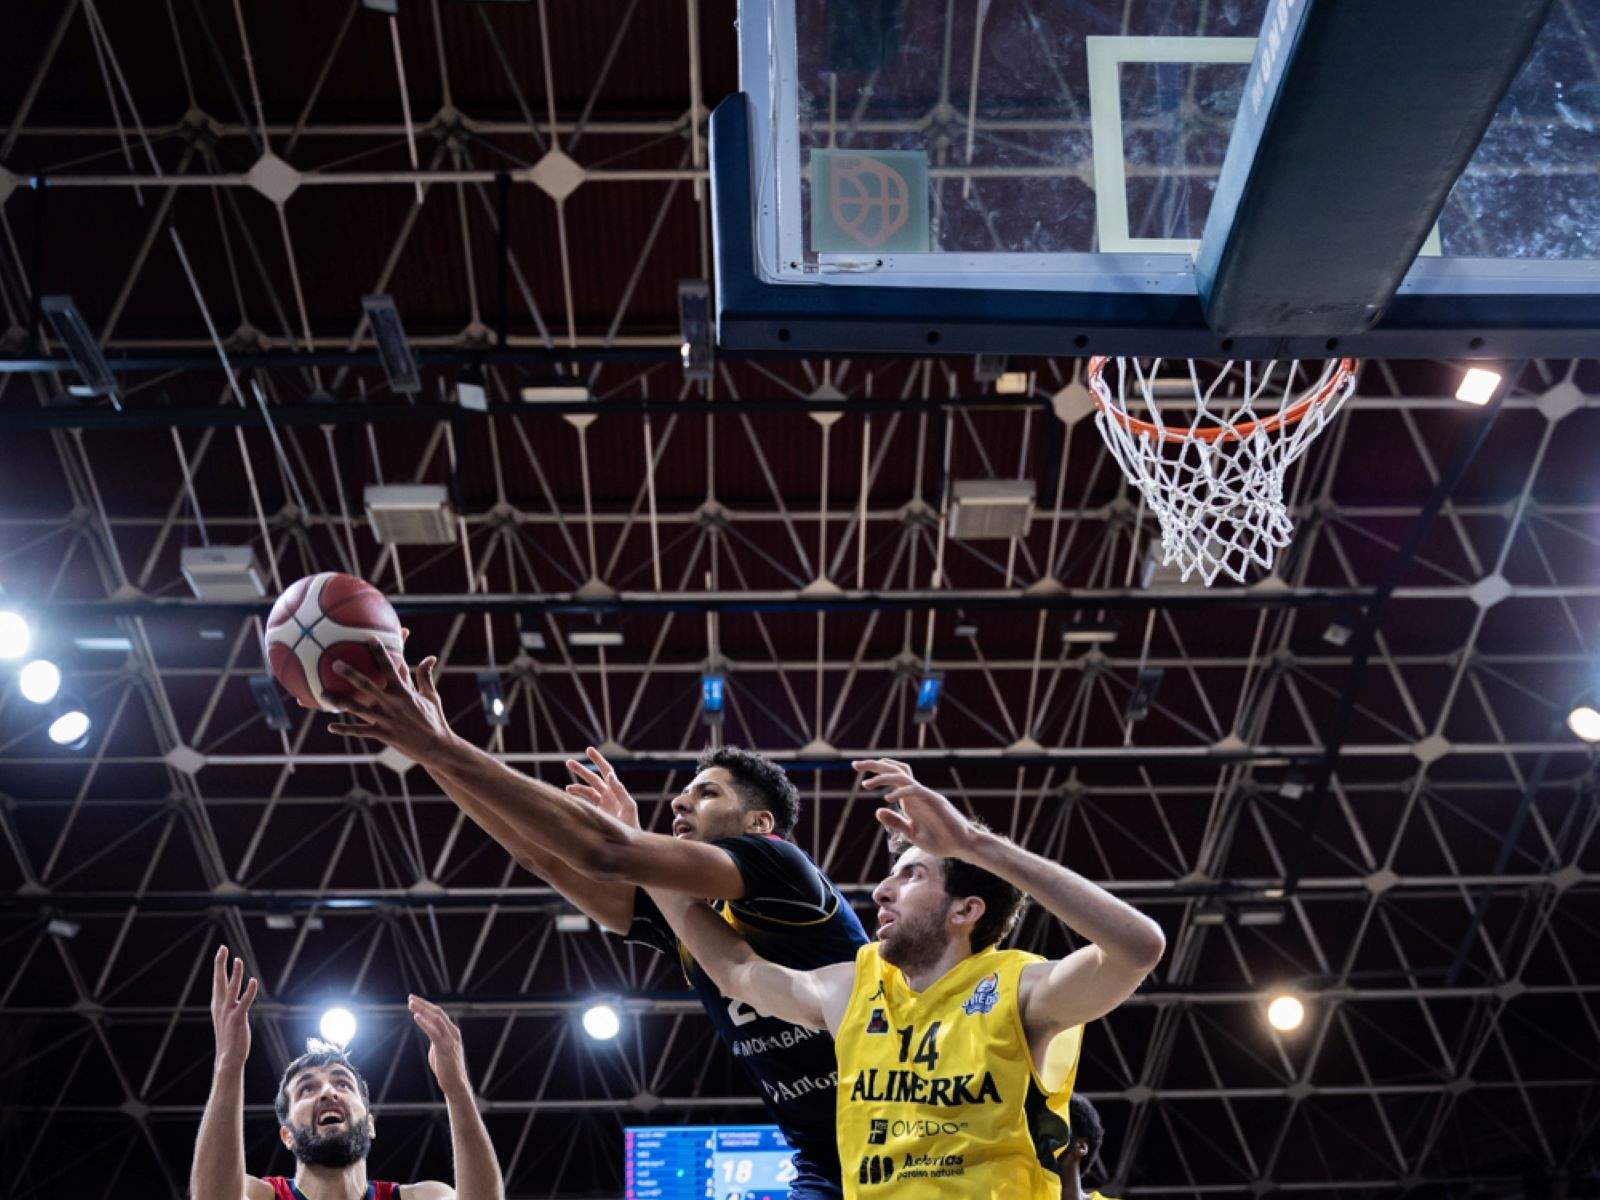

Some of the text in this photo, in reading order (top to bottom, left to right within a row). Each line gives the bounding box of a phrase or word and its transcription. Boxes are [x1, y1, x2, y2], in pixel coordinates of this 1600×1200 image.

[896, 1020, 943, 1071] 14
[850, 1067, 1003, 1106] ALIMERKA
[722, 1159, 753, 1184] 18
